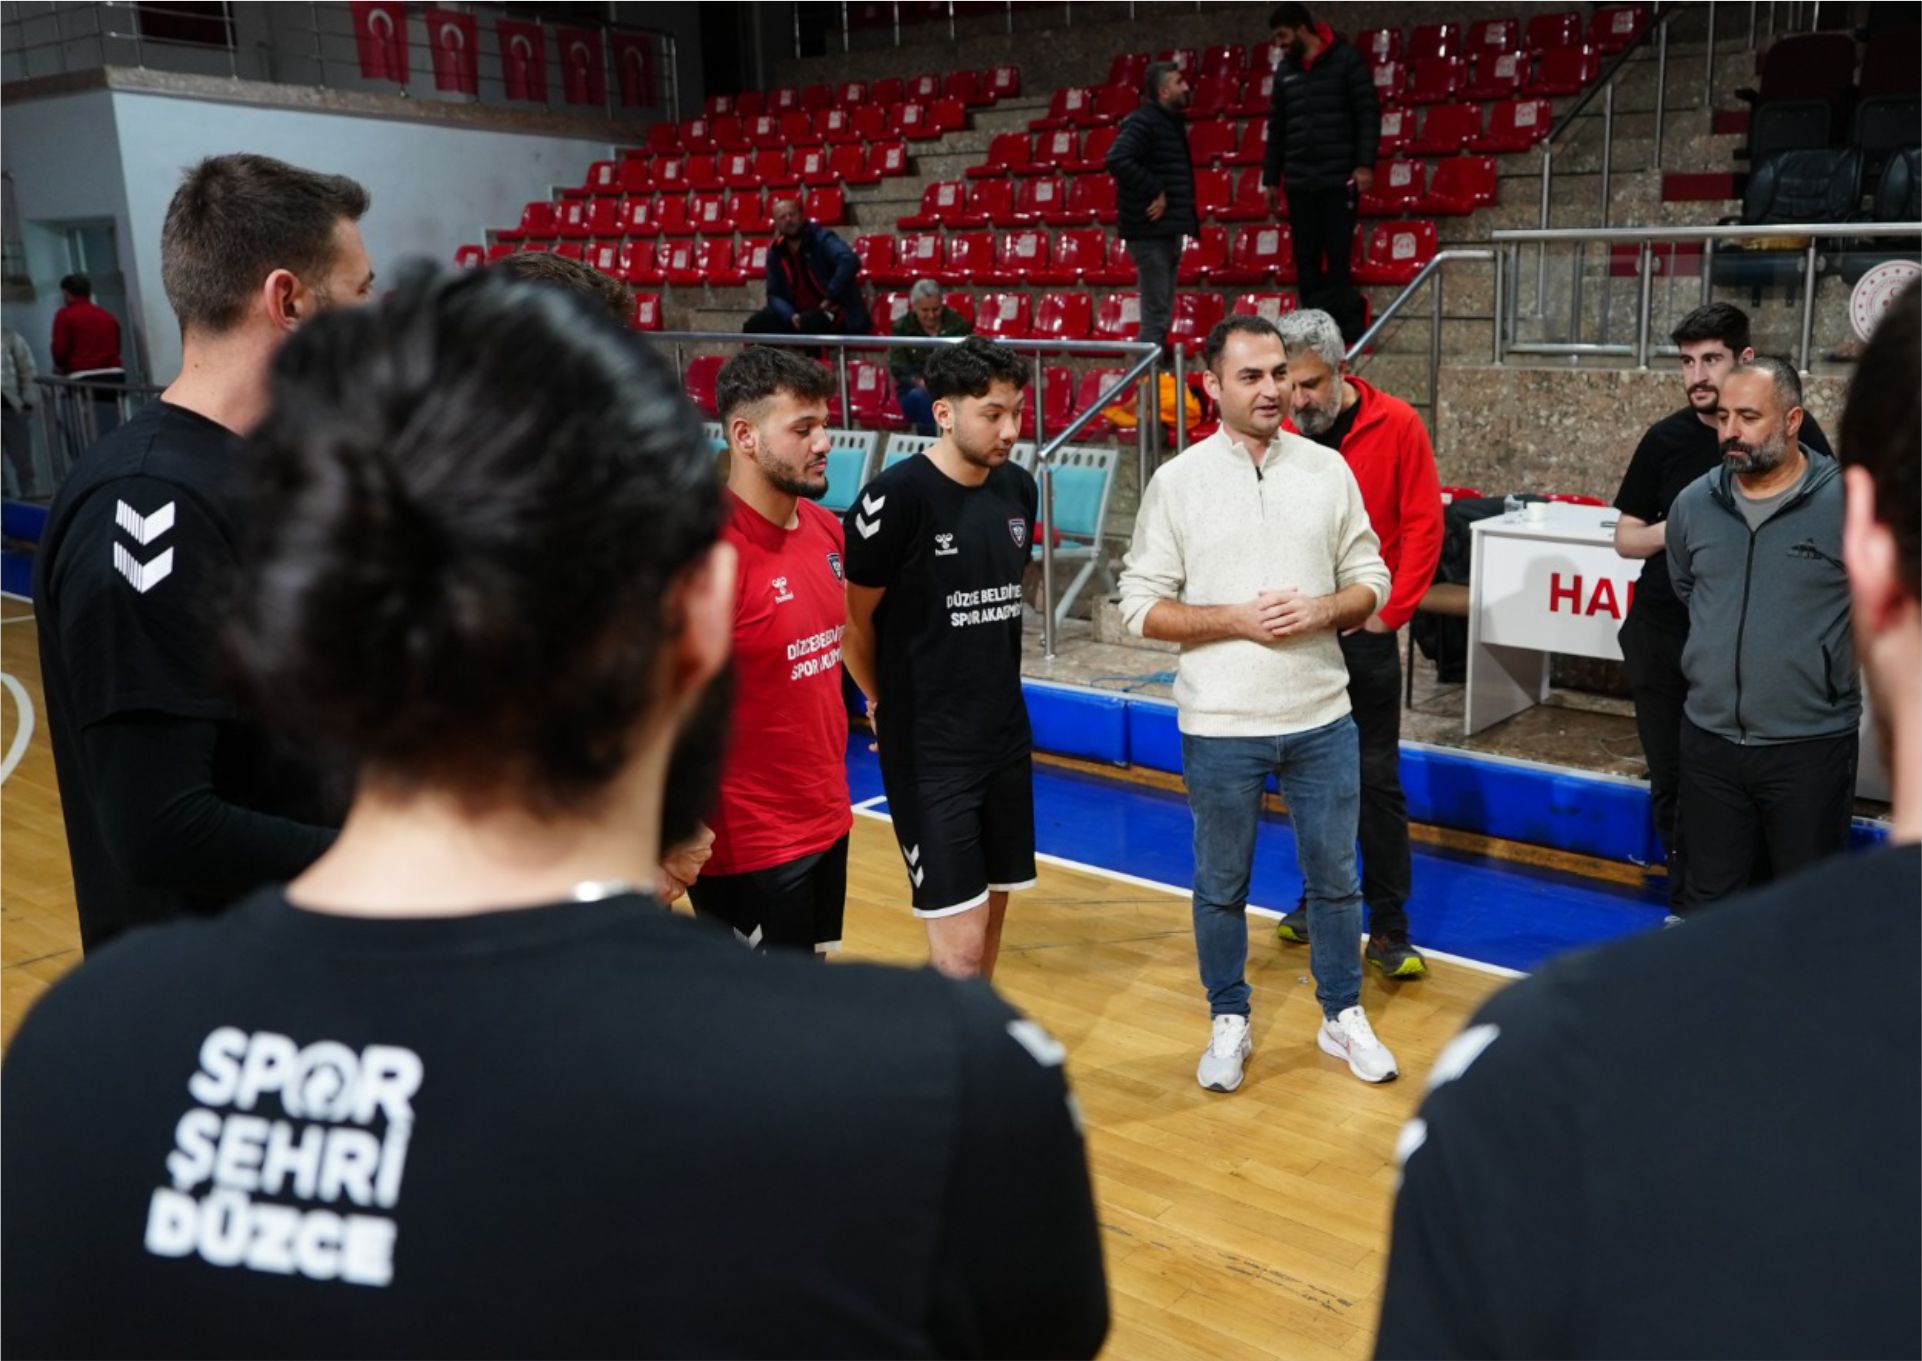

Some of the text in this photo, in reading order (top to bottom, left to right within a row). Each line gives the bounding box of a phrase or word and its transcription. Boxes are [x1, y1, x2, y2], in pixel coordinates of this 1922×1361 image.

[187, 1025, 423, 1126] SPOR
[166, 1108, 413, 1211] ŞEHRİ
[143, 1183, 398, 1288] DÜZCE
